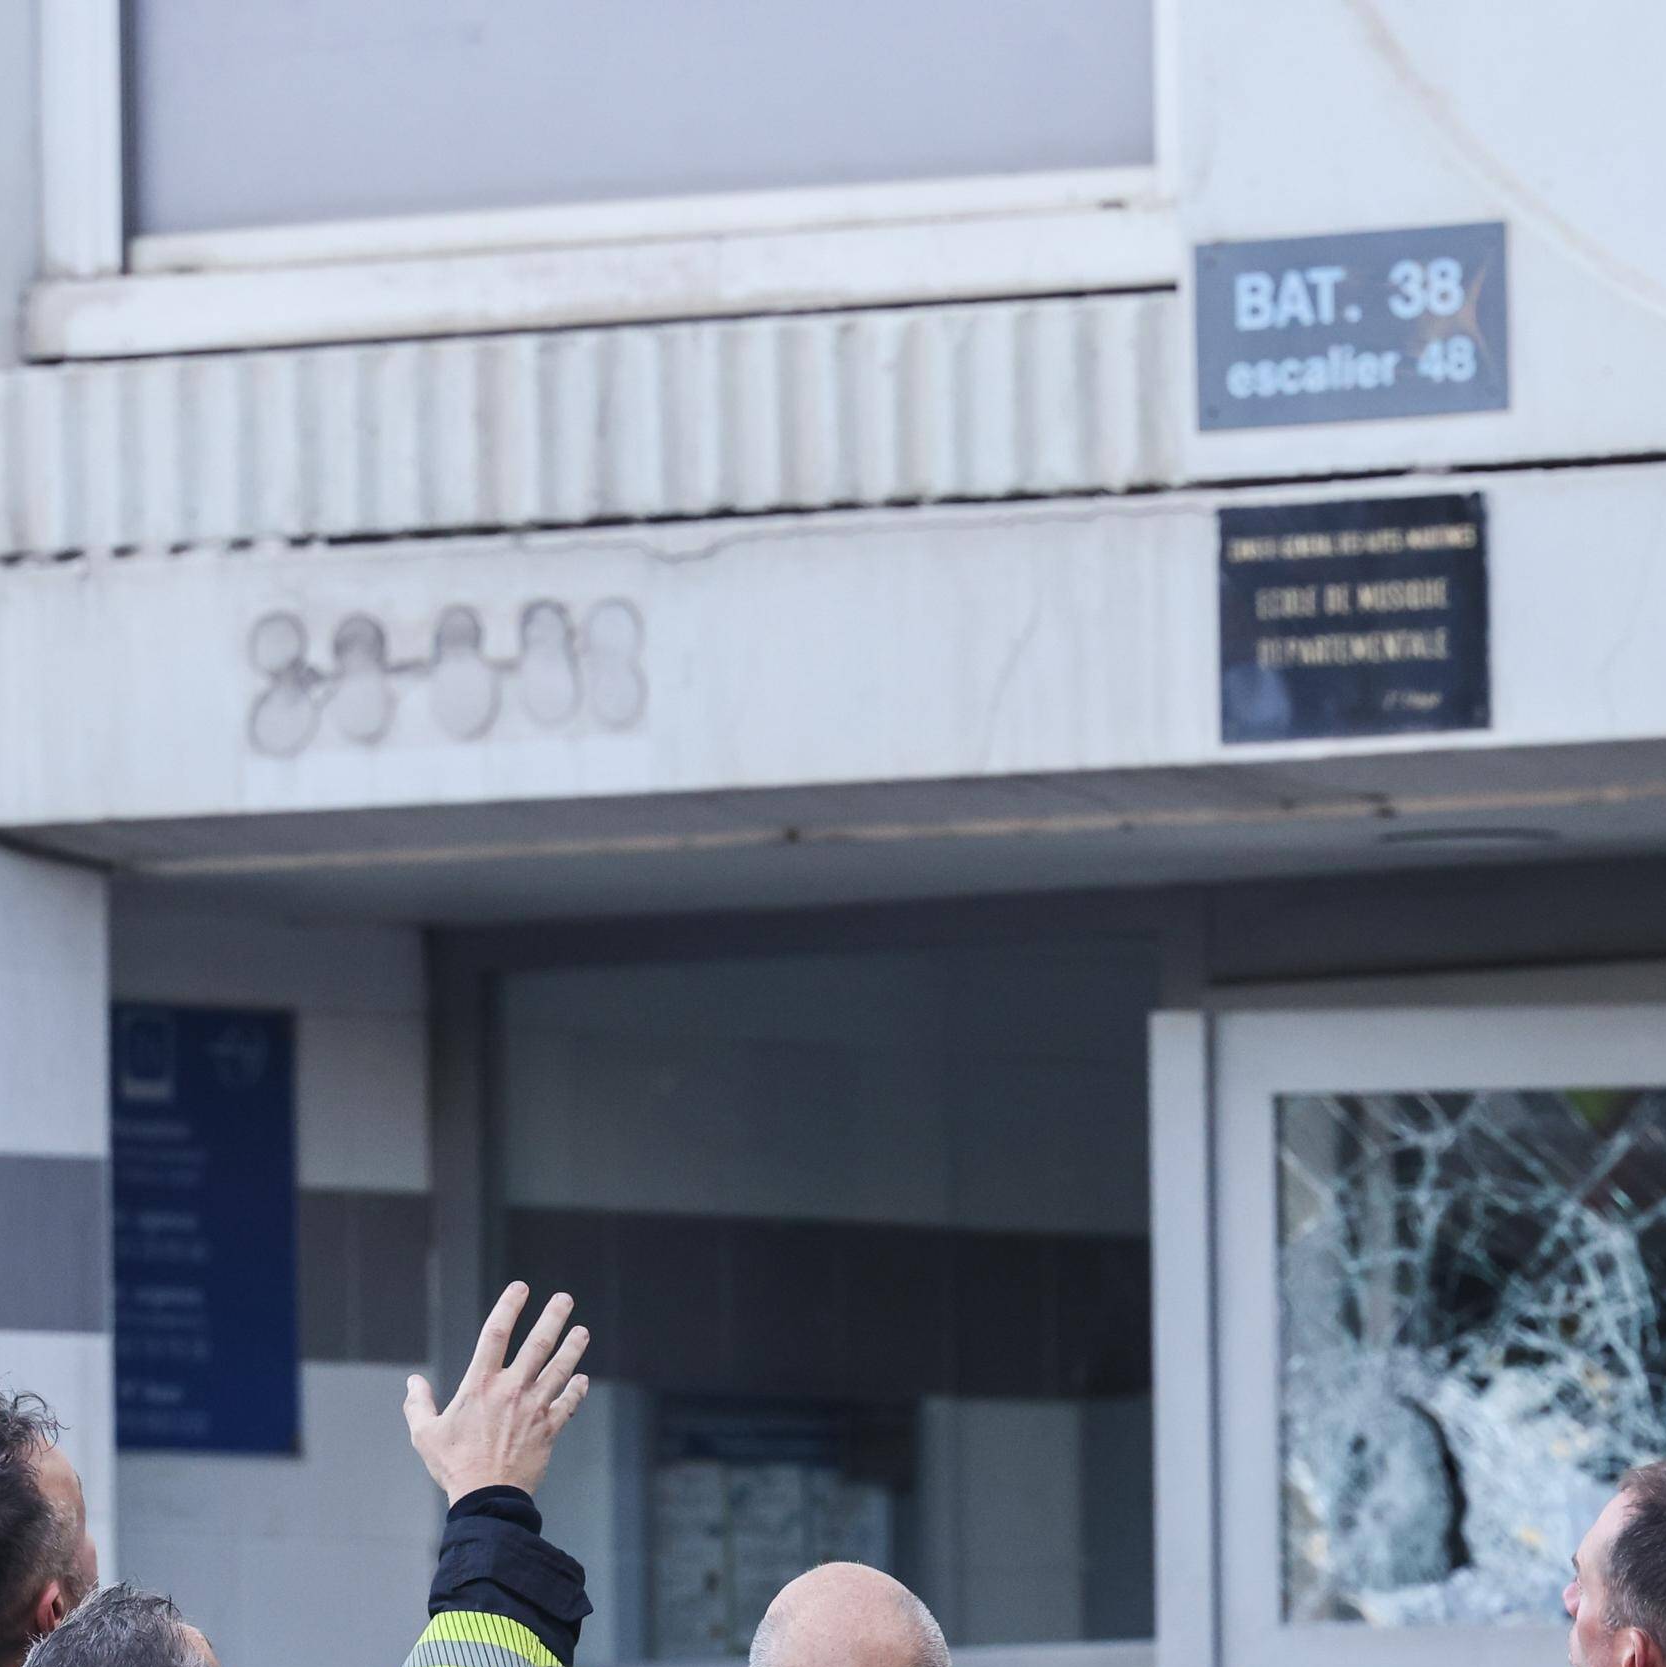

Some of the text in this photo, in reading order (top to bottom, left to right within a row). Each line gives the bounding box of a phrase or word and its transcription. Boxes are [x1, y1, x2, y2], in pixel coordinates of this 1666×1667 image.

[1235, 257, 1465, 331] BAT. 38
[1226, 335, 1477, 399] escalier 48
